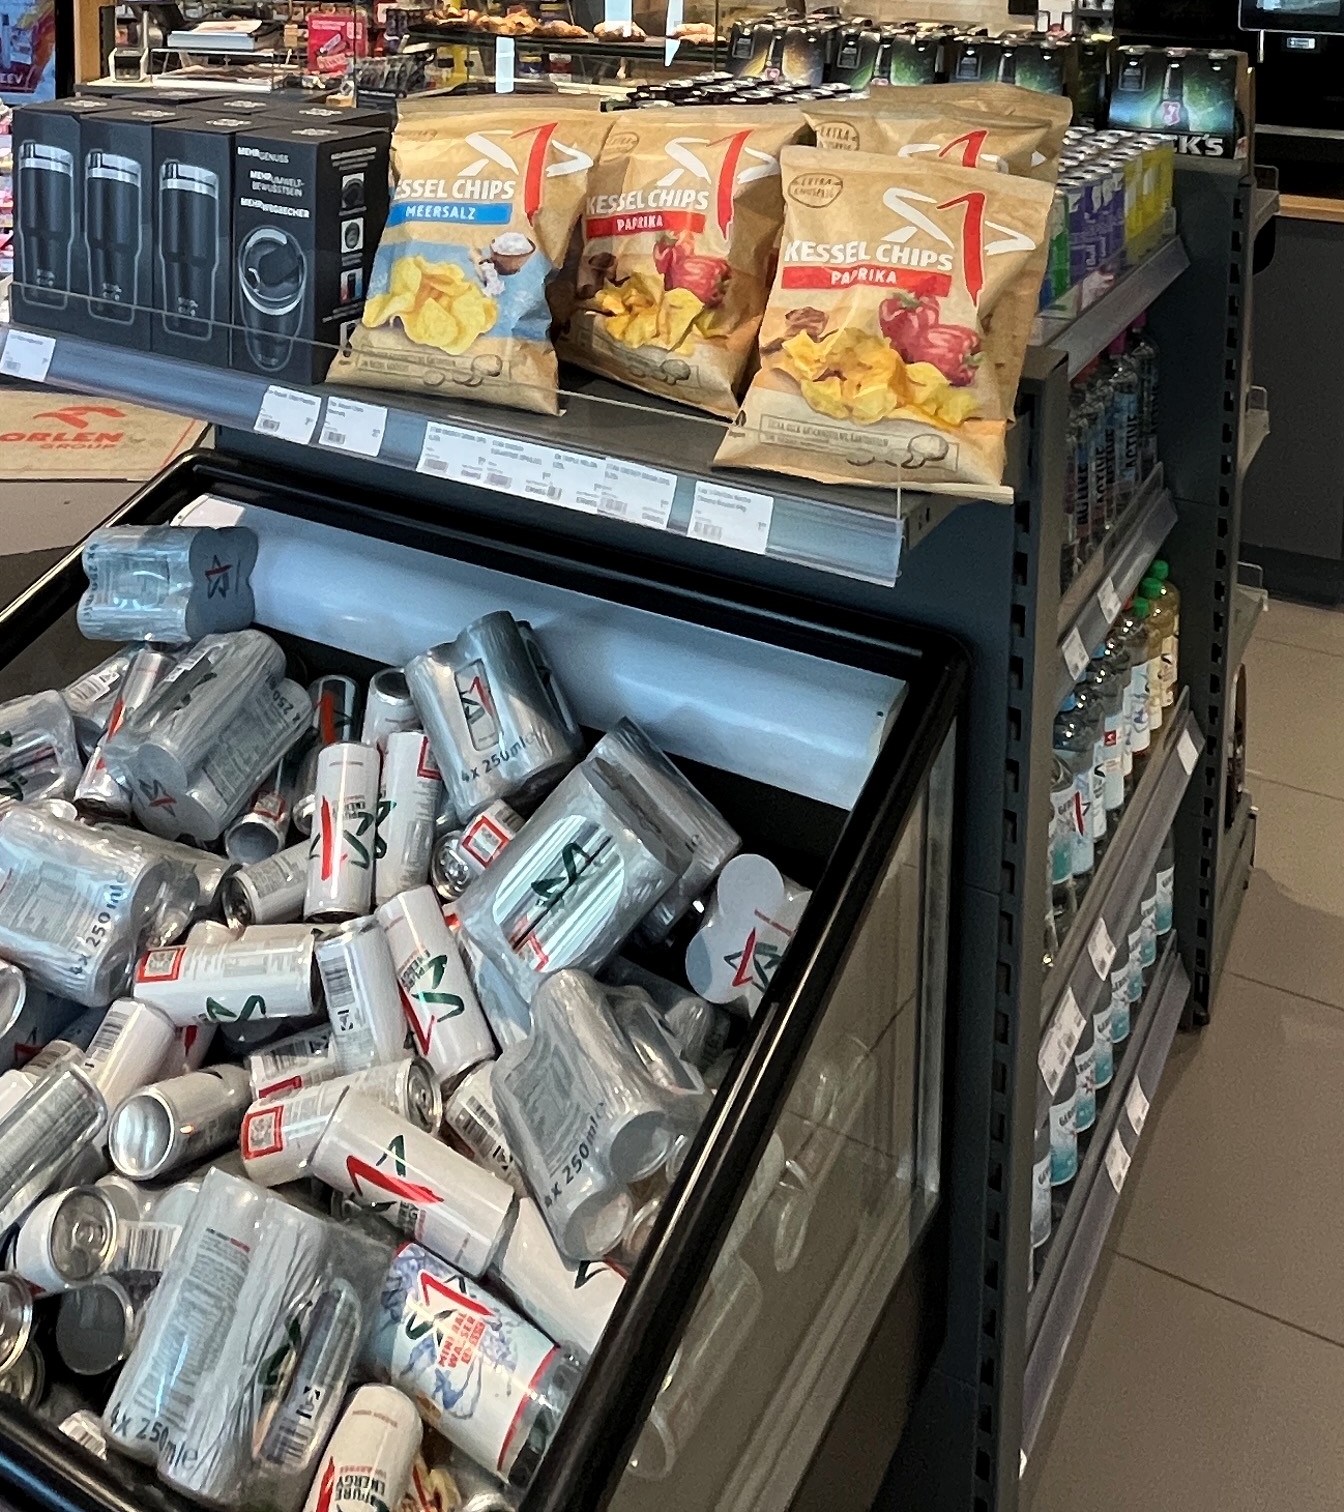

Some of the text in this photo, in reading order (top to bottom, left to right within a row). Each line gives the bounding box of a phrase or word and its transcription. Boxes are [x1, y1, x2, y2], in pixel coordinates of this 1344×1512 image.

[394, 179, 516, 200] ESSEL CHIPS
[586, 189, 710, 215] KESSEL CHIPS
[405, 204, 476, 221] MEERSALZ
[616, 214, 664, 232] PAPRIKA
[783, 239, 954, 273] KESSEL CHIPS
[830, 266, 898, 286] PAPRIKA
